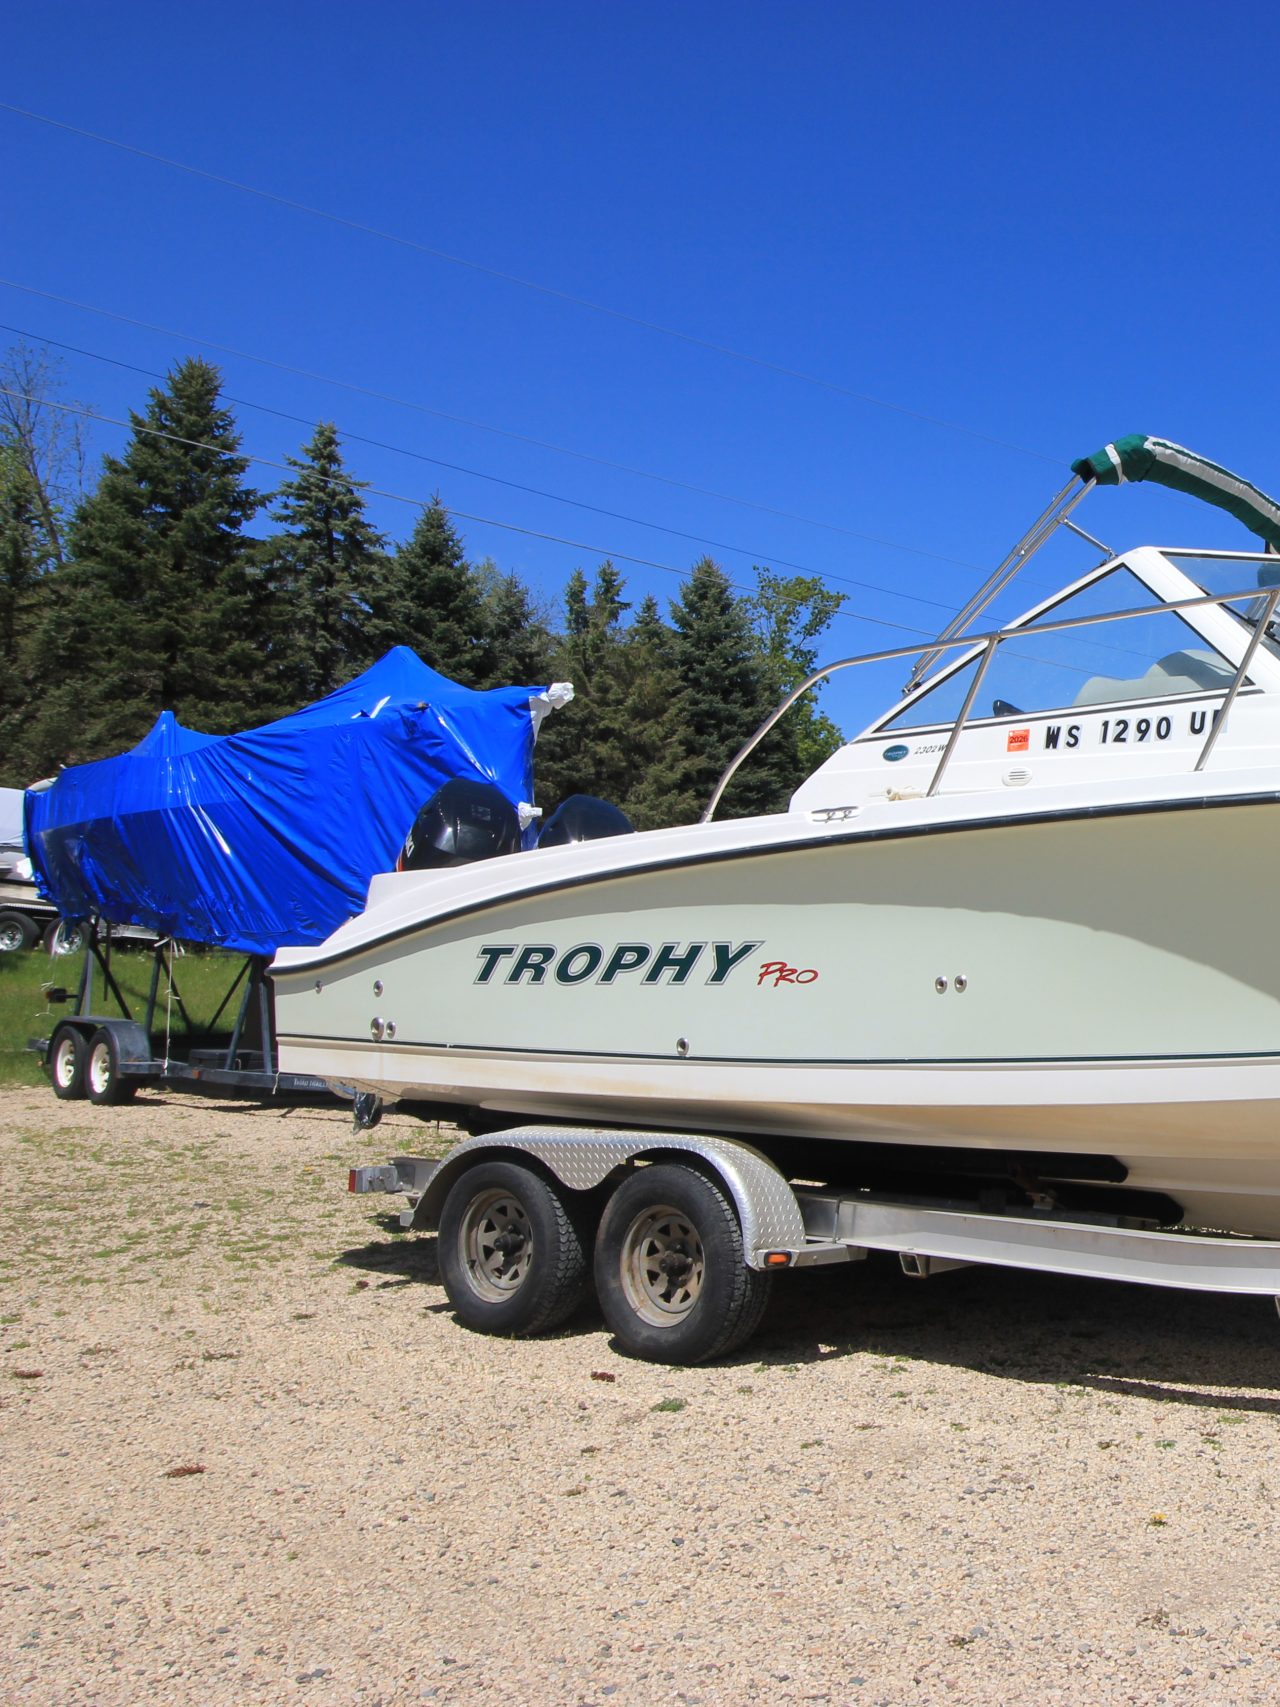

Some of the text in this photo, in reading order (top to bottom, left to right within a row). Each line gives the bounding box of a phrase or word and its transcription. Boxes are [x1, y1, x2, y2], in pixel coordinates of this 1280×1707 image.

[1045, 725, 1081, 749] WS
[1101, 716, 1171, 744] 1290
[473, 941, 765, 985] TROPHY
